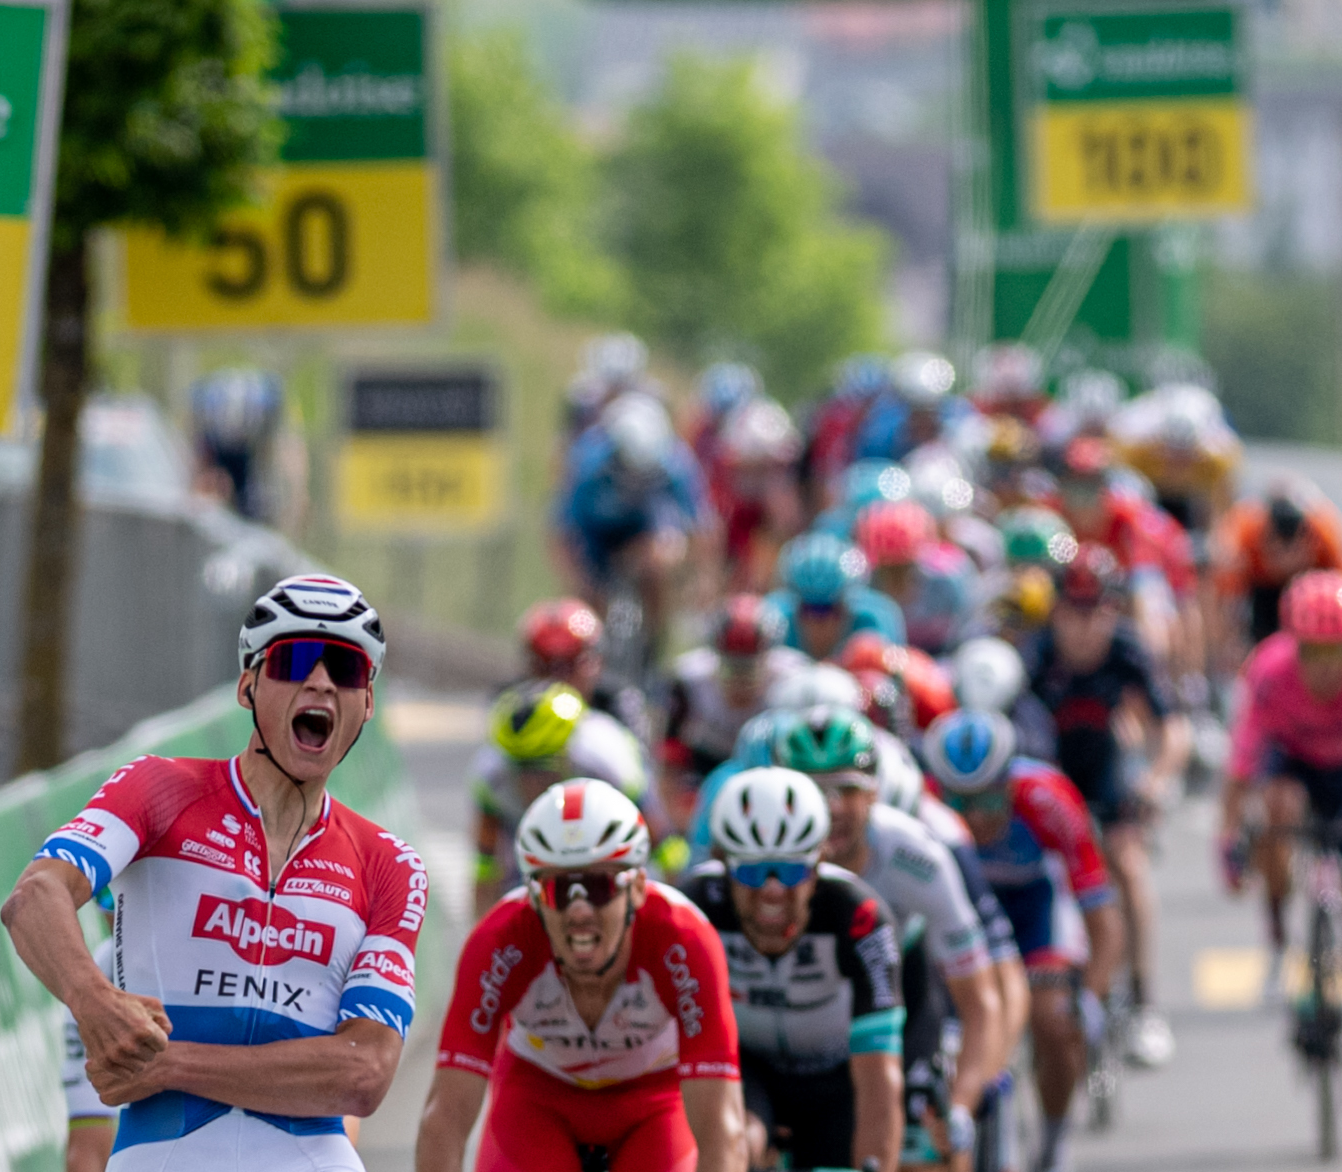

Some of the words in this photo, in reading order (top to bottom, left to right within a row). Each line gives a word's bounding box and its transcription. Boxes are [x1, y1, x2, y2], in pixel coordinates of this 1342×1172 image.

[204, 188, 352, 303] 50
[292, 857, 356, 880] CANYON
[378, 831, 428, 932] Alpecin
[203, 902, 324, 957] Alpecin
[194, 969, 305, 1013] FENIX
